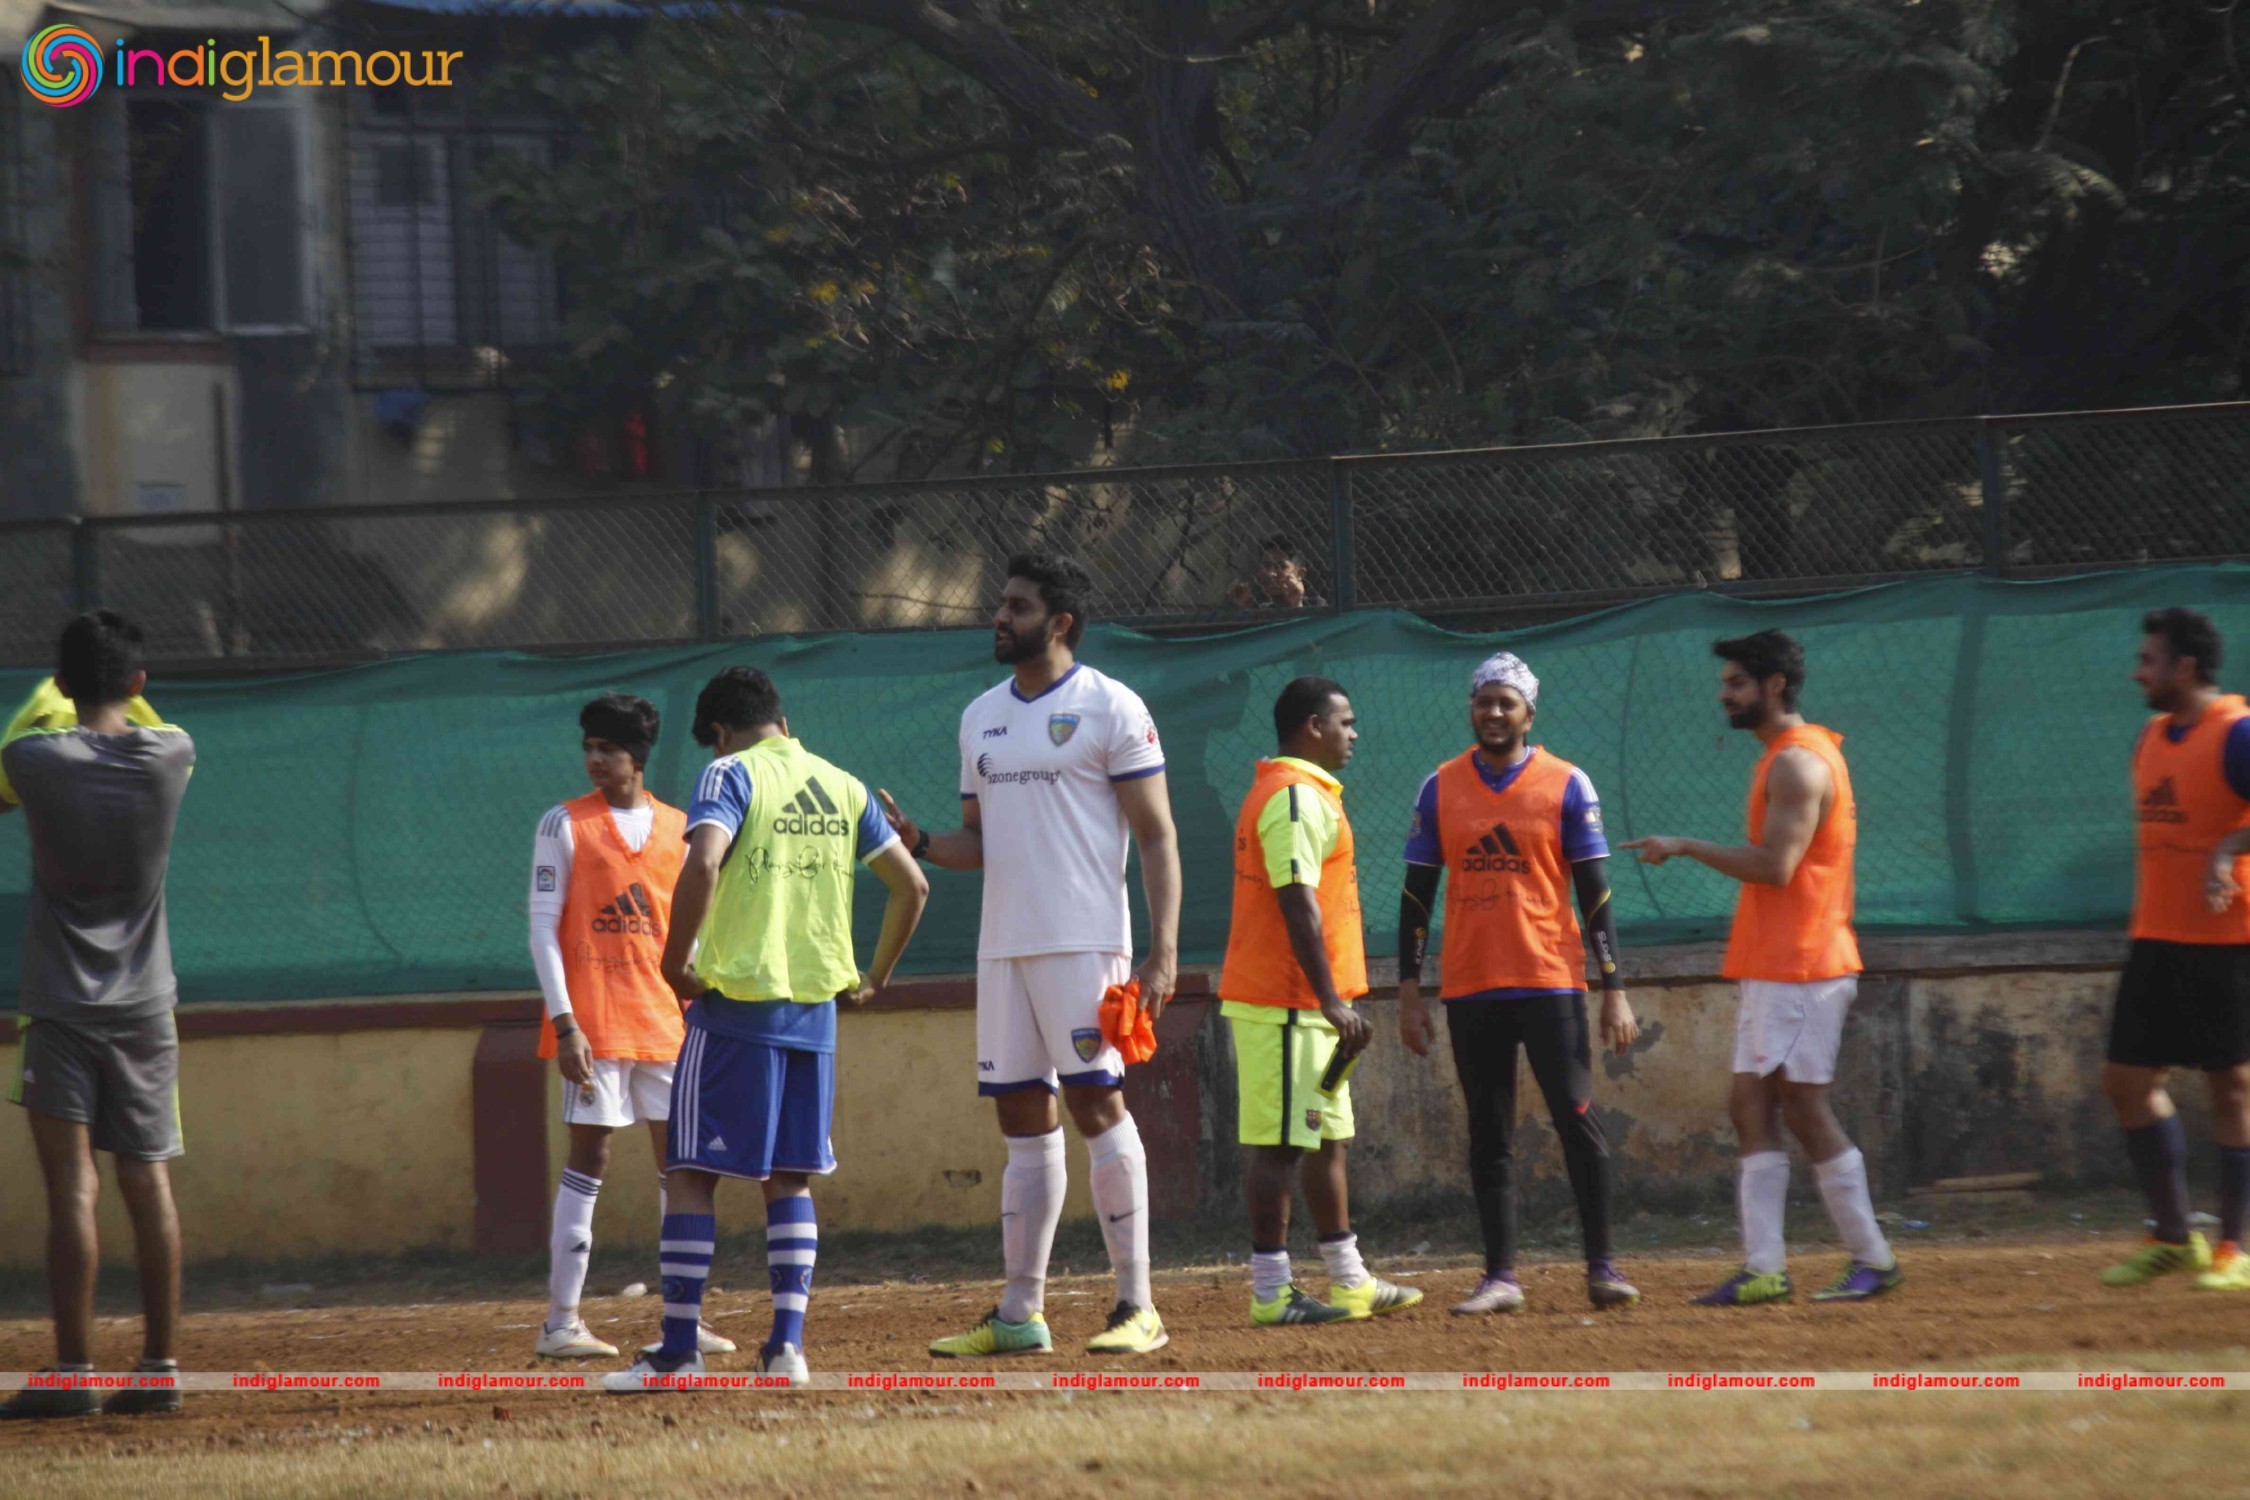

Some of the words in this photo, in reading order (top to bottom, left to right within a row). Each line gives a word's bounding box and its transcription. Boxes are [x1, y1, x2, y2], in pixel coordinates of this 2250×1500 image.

[773, 815, 850, 836] adidas
[1463, 855, 1532, 875] adidas
[591, 915, 661, 937] adidas
